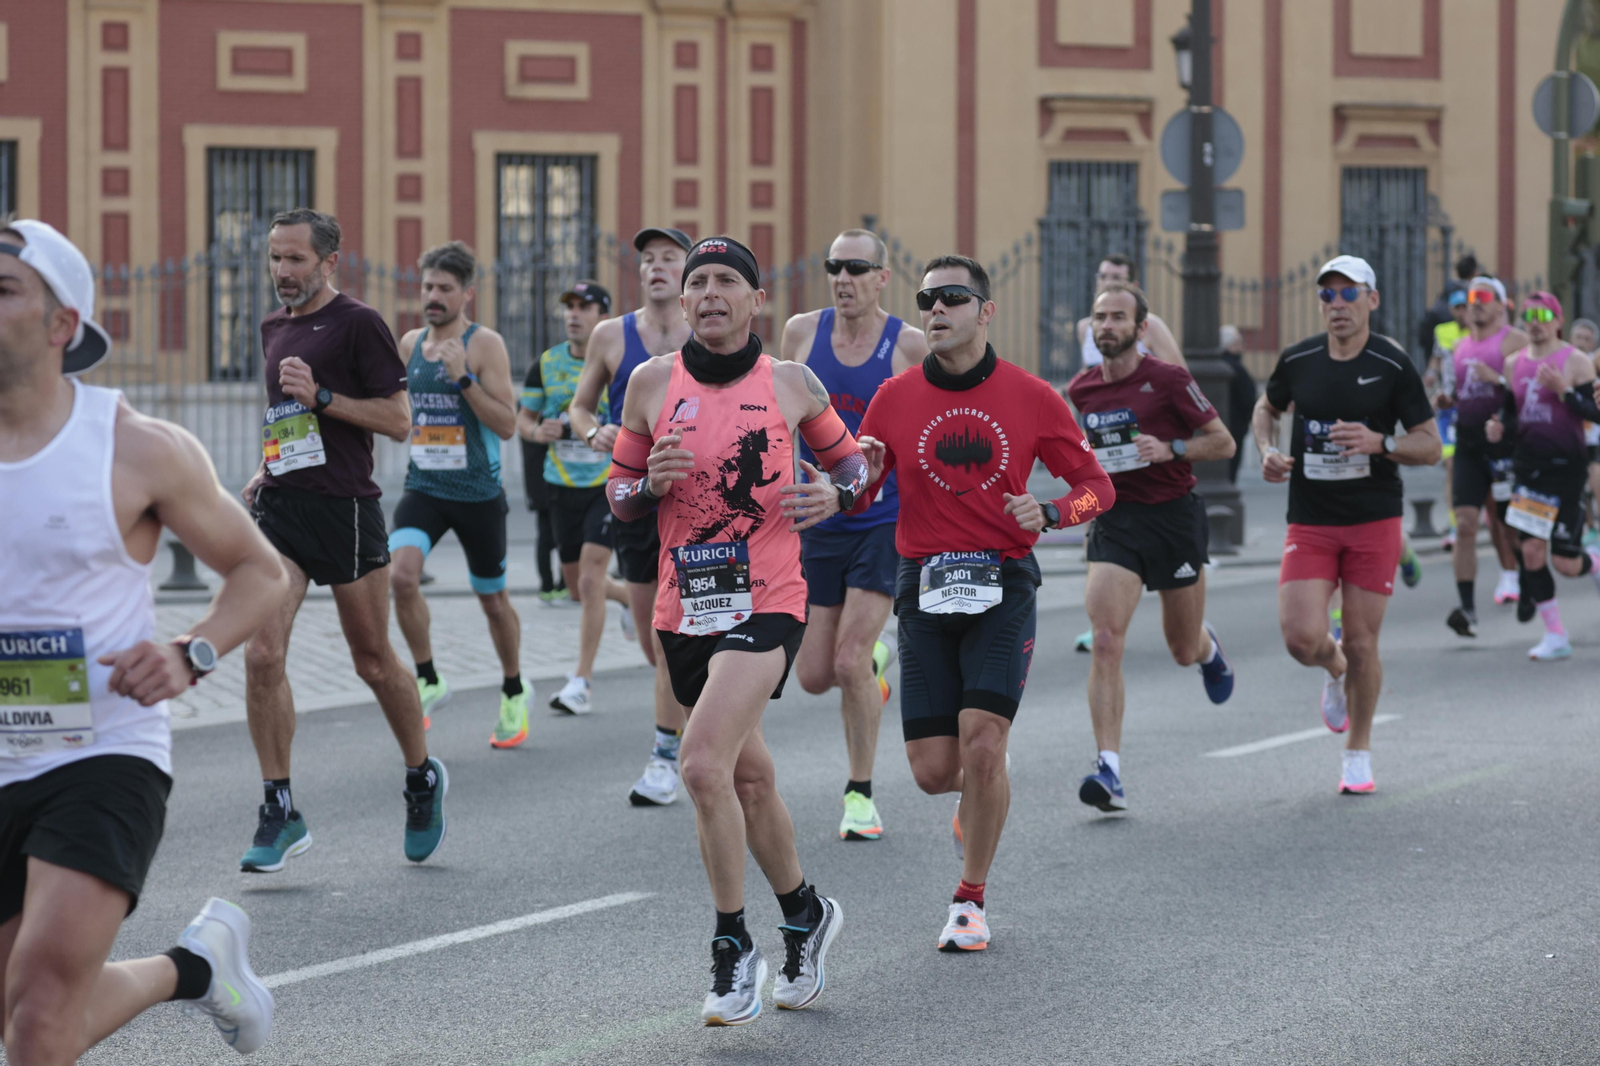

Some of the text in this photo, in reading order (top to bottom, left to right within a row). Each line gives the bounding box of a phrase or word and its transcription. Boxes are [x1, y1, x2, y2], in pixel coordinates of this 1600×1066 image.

[697, 246, 728, 255] 365
[877, 337, 892, 360] soar
[427, 415, 458, 425] ZURICH
[1100, 411, 1130, 425] ZURICH
[917, 407, 1010, 491] BANK OF AMERICA CHICAGO MARATHON 2019
[684, 546, 737, 562] ZURICH
[942, 551, 991, 560] ZURICH
[945, 569, 971, 583] 2401
[941, 586, 977, 598] NÉSTOR
[0, 635, 67, 655] URICH
